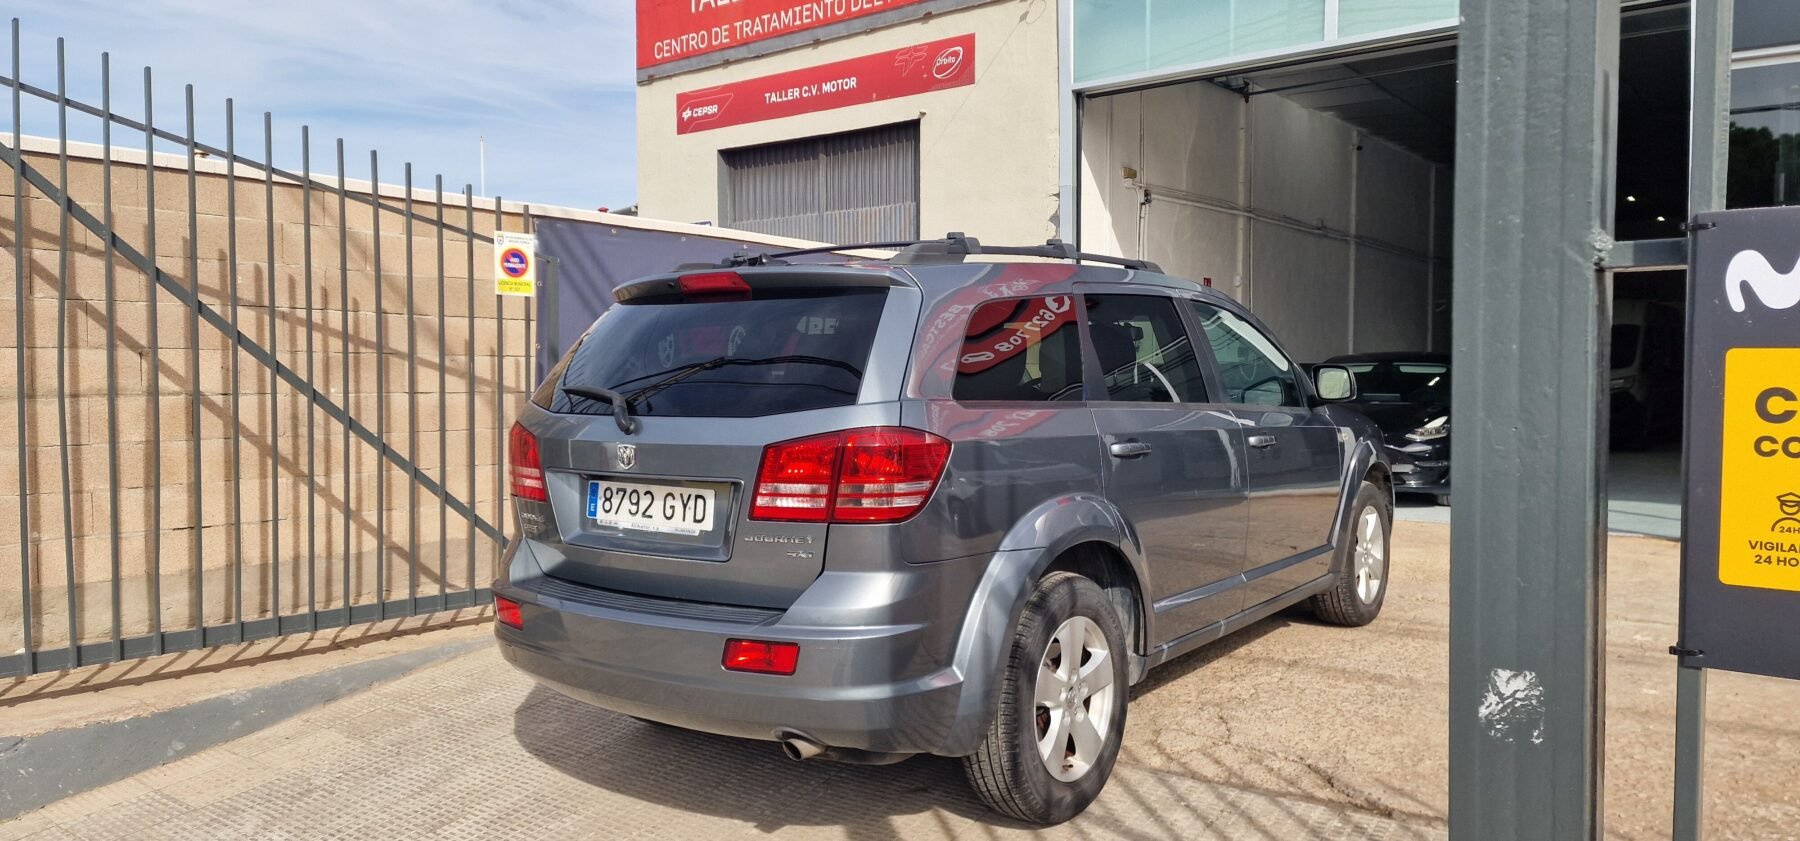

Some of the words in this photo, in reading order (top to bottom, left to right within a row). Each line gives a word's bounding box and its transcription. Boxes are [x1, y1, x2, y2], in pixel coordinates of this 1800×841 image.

[654, 30, 708, 59] CENTRO
[711, 25, 731, 46] DE
[734, 0, 846, 39] TRATAMIENTO
[765, 91, 800, 104] TALLER
[802, 84, 820, 97] C.V.
[822, 76, 857, 94] MOTOR
[602, 486, 655, 519] 8792
[662, 491, 707, 524] GYD
[744, 534, 814, 544] JOURNEY
[1748, 540, 1800, 554] VIGILA
[1754, 554, 1773, 565] 24
